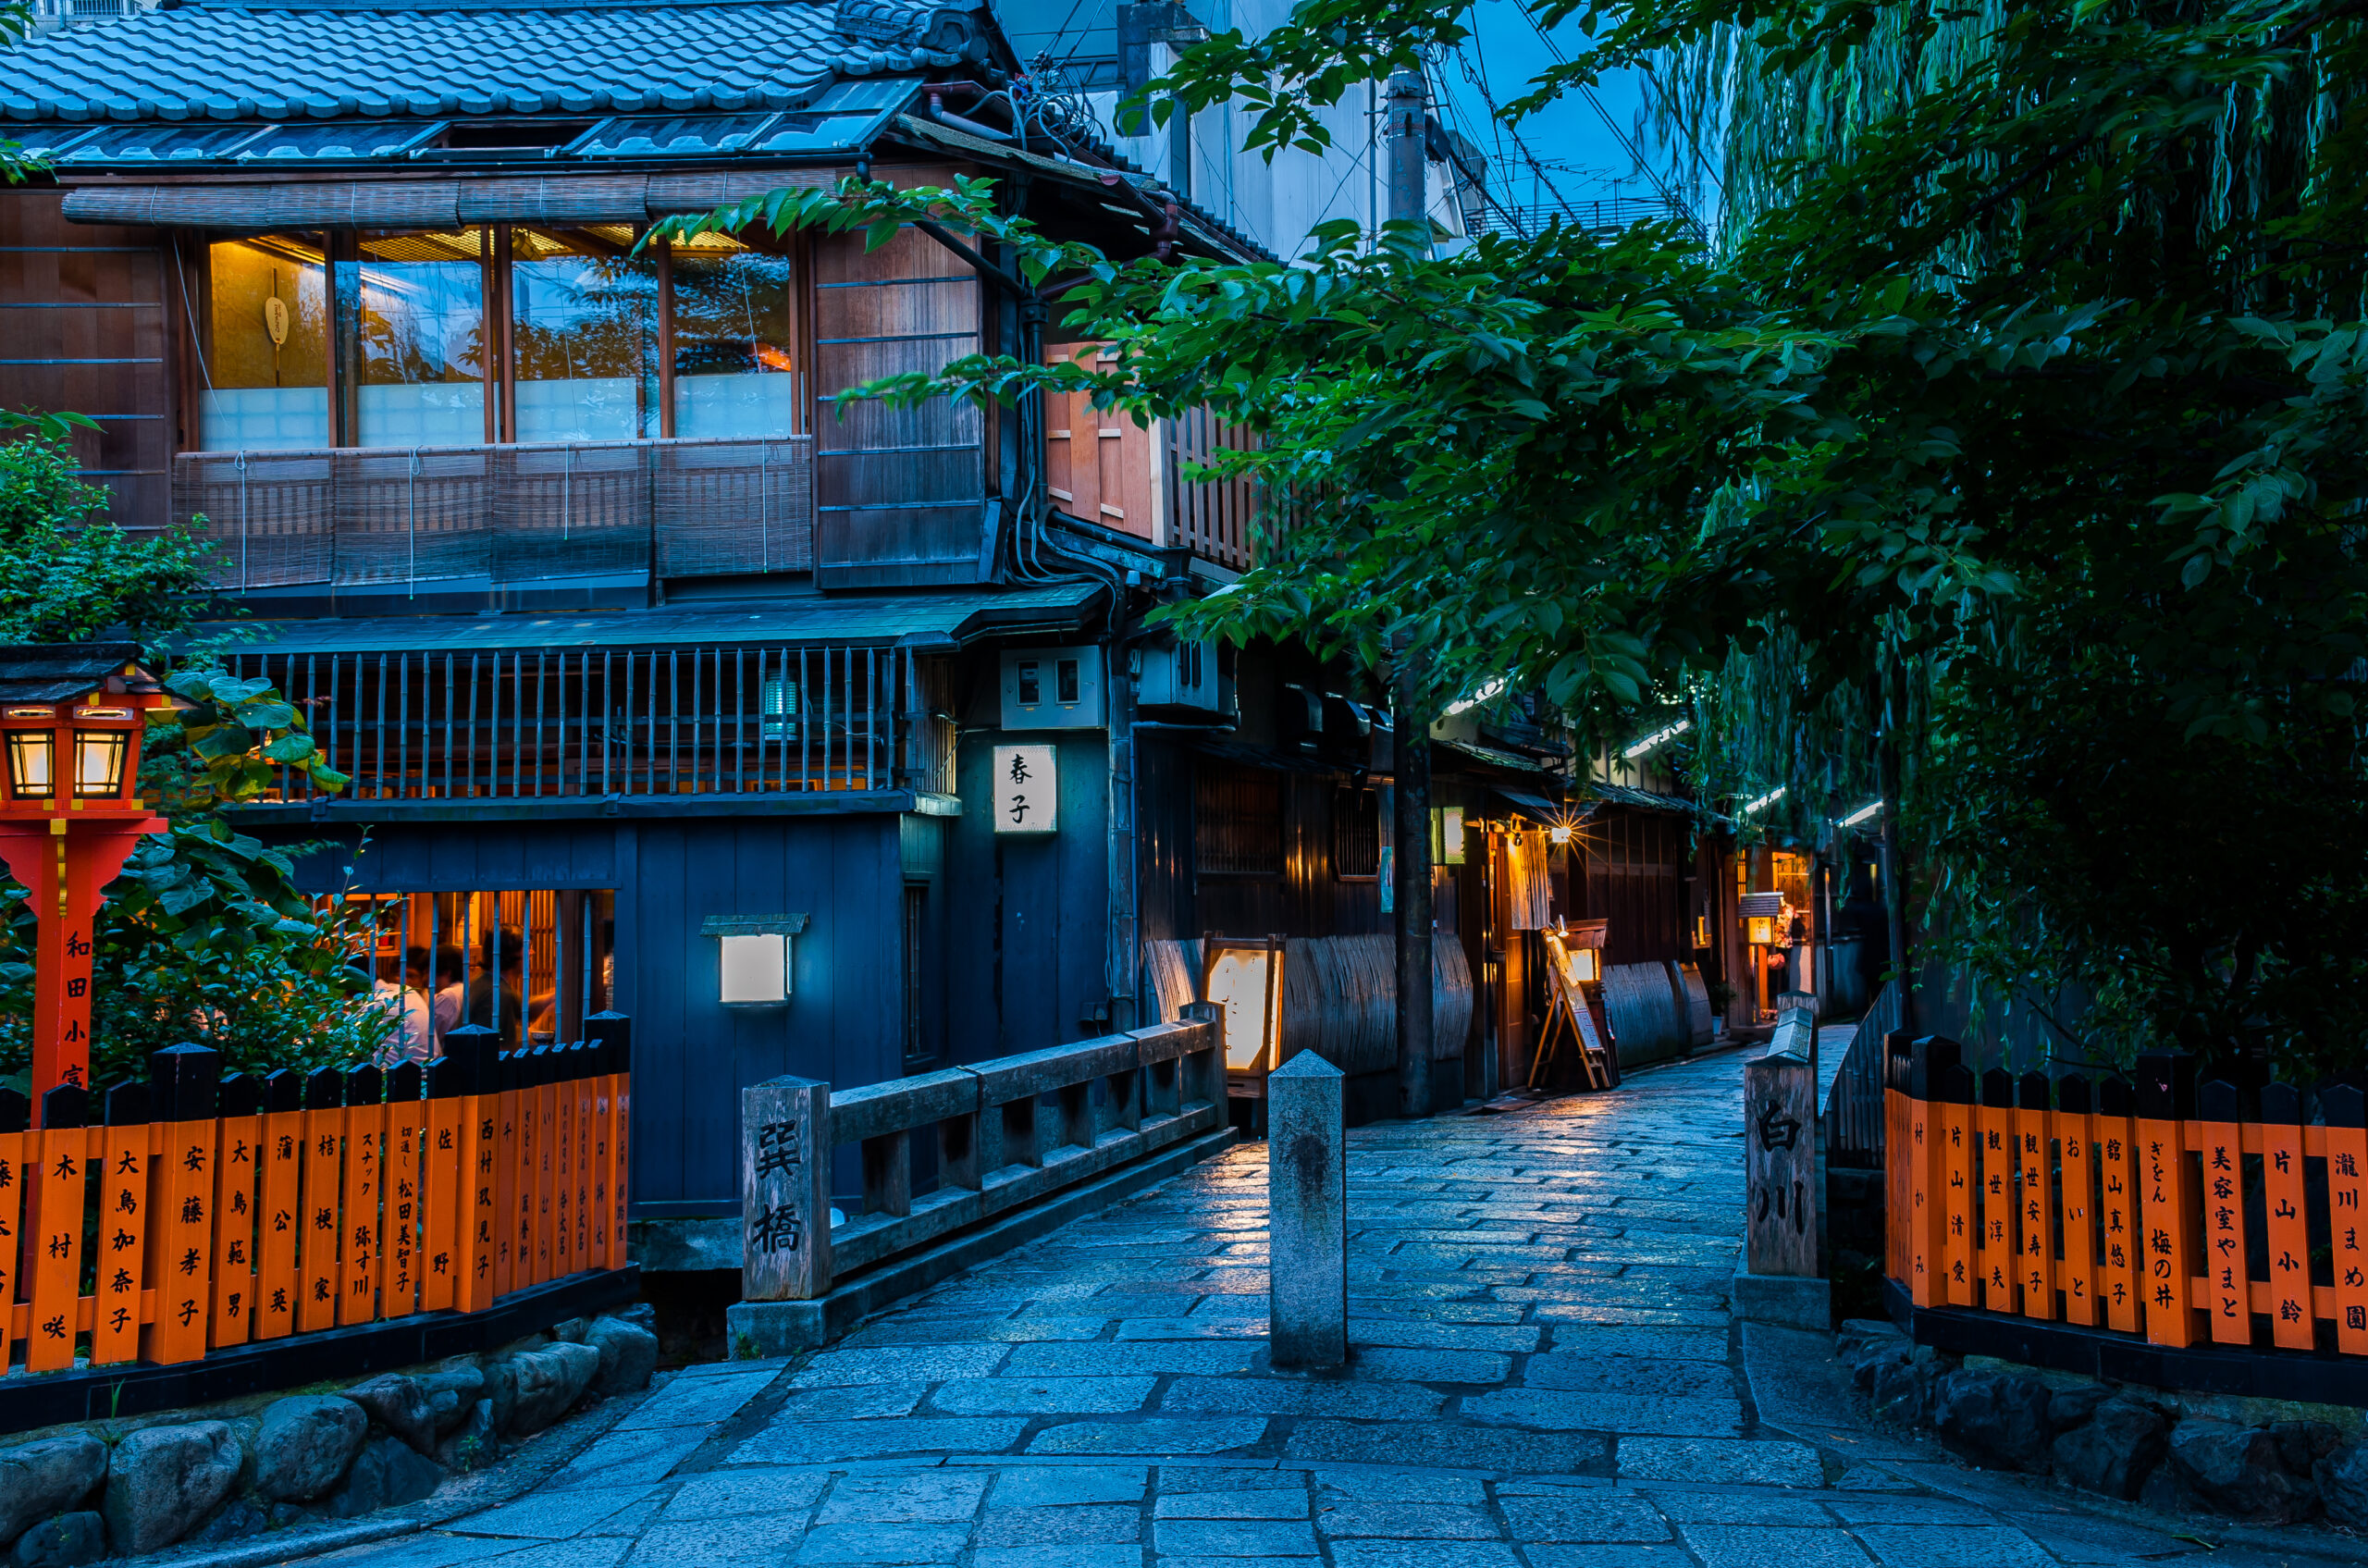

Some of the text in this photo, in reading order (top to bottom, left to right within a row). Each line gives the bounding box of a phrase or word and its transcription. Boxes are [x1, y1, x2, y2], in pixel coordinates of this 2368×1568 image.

[1009, 753, 1033, 824] 春子
[43, 1154, 78, 1340] 木村咲
[108, 1150, 140, 1334] 大鳥加奈子
[178, 1145, 206, 1327] 安藤孝子
[226, 1139, 249, 1318] 大鳥範男
[269, 1135, 294, 1314] 蒲公英
[314, 1134, 337, 1303] 桔梗家
[433, 1128, 453, 1276] 佐野
[753, 1119, 801, 1254] 巽橋
[1757, 1099, 1804, 1236] 白川
[1914, 1122, 1925, 1274] 村かみ
[1951, 1125, 1966, 1285] 片山清愛
[1988, 1129, 2005, 1290] 観世淳夫
[2025, 1131, 2043, 1293] 観世安寿子
[2066, 1136, 2086, 1298] おいと
[2211, 1146, 2238, 1318] 美容室やまと
[2274, 1150, 2303, 1324] 片山小鈴
[2334, 1153, 2367, 1331] 瀧川まめ園
